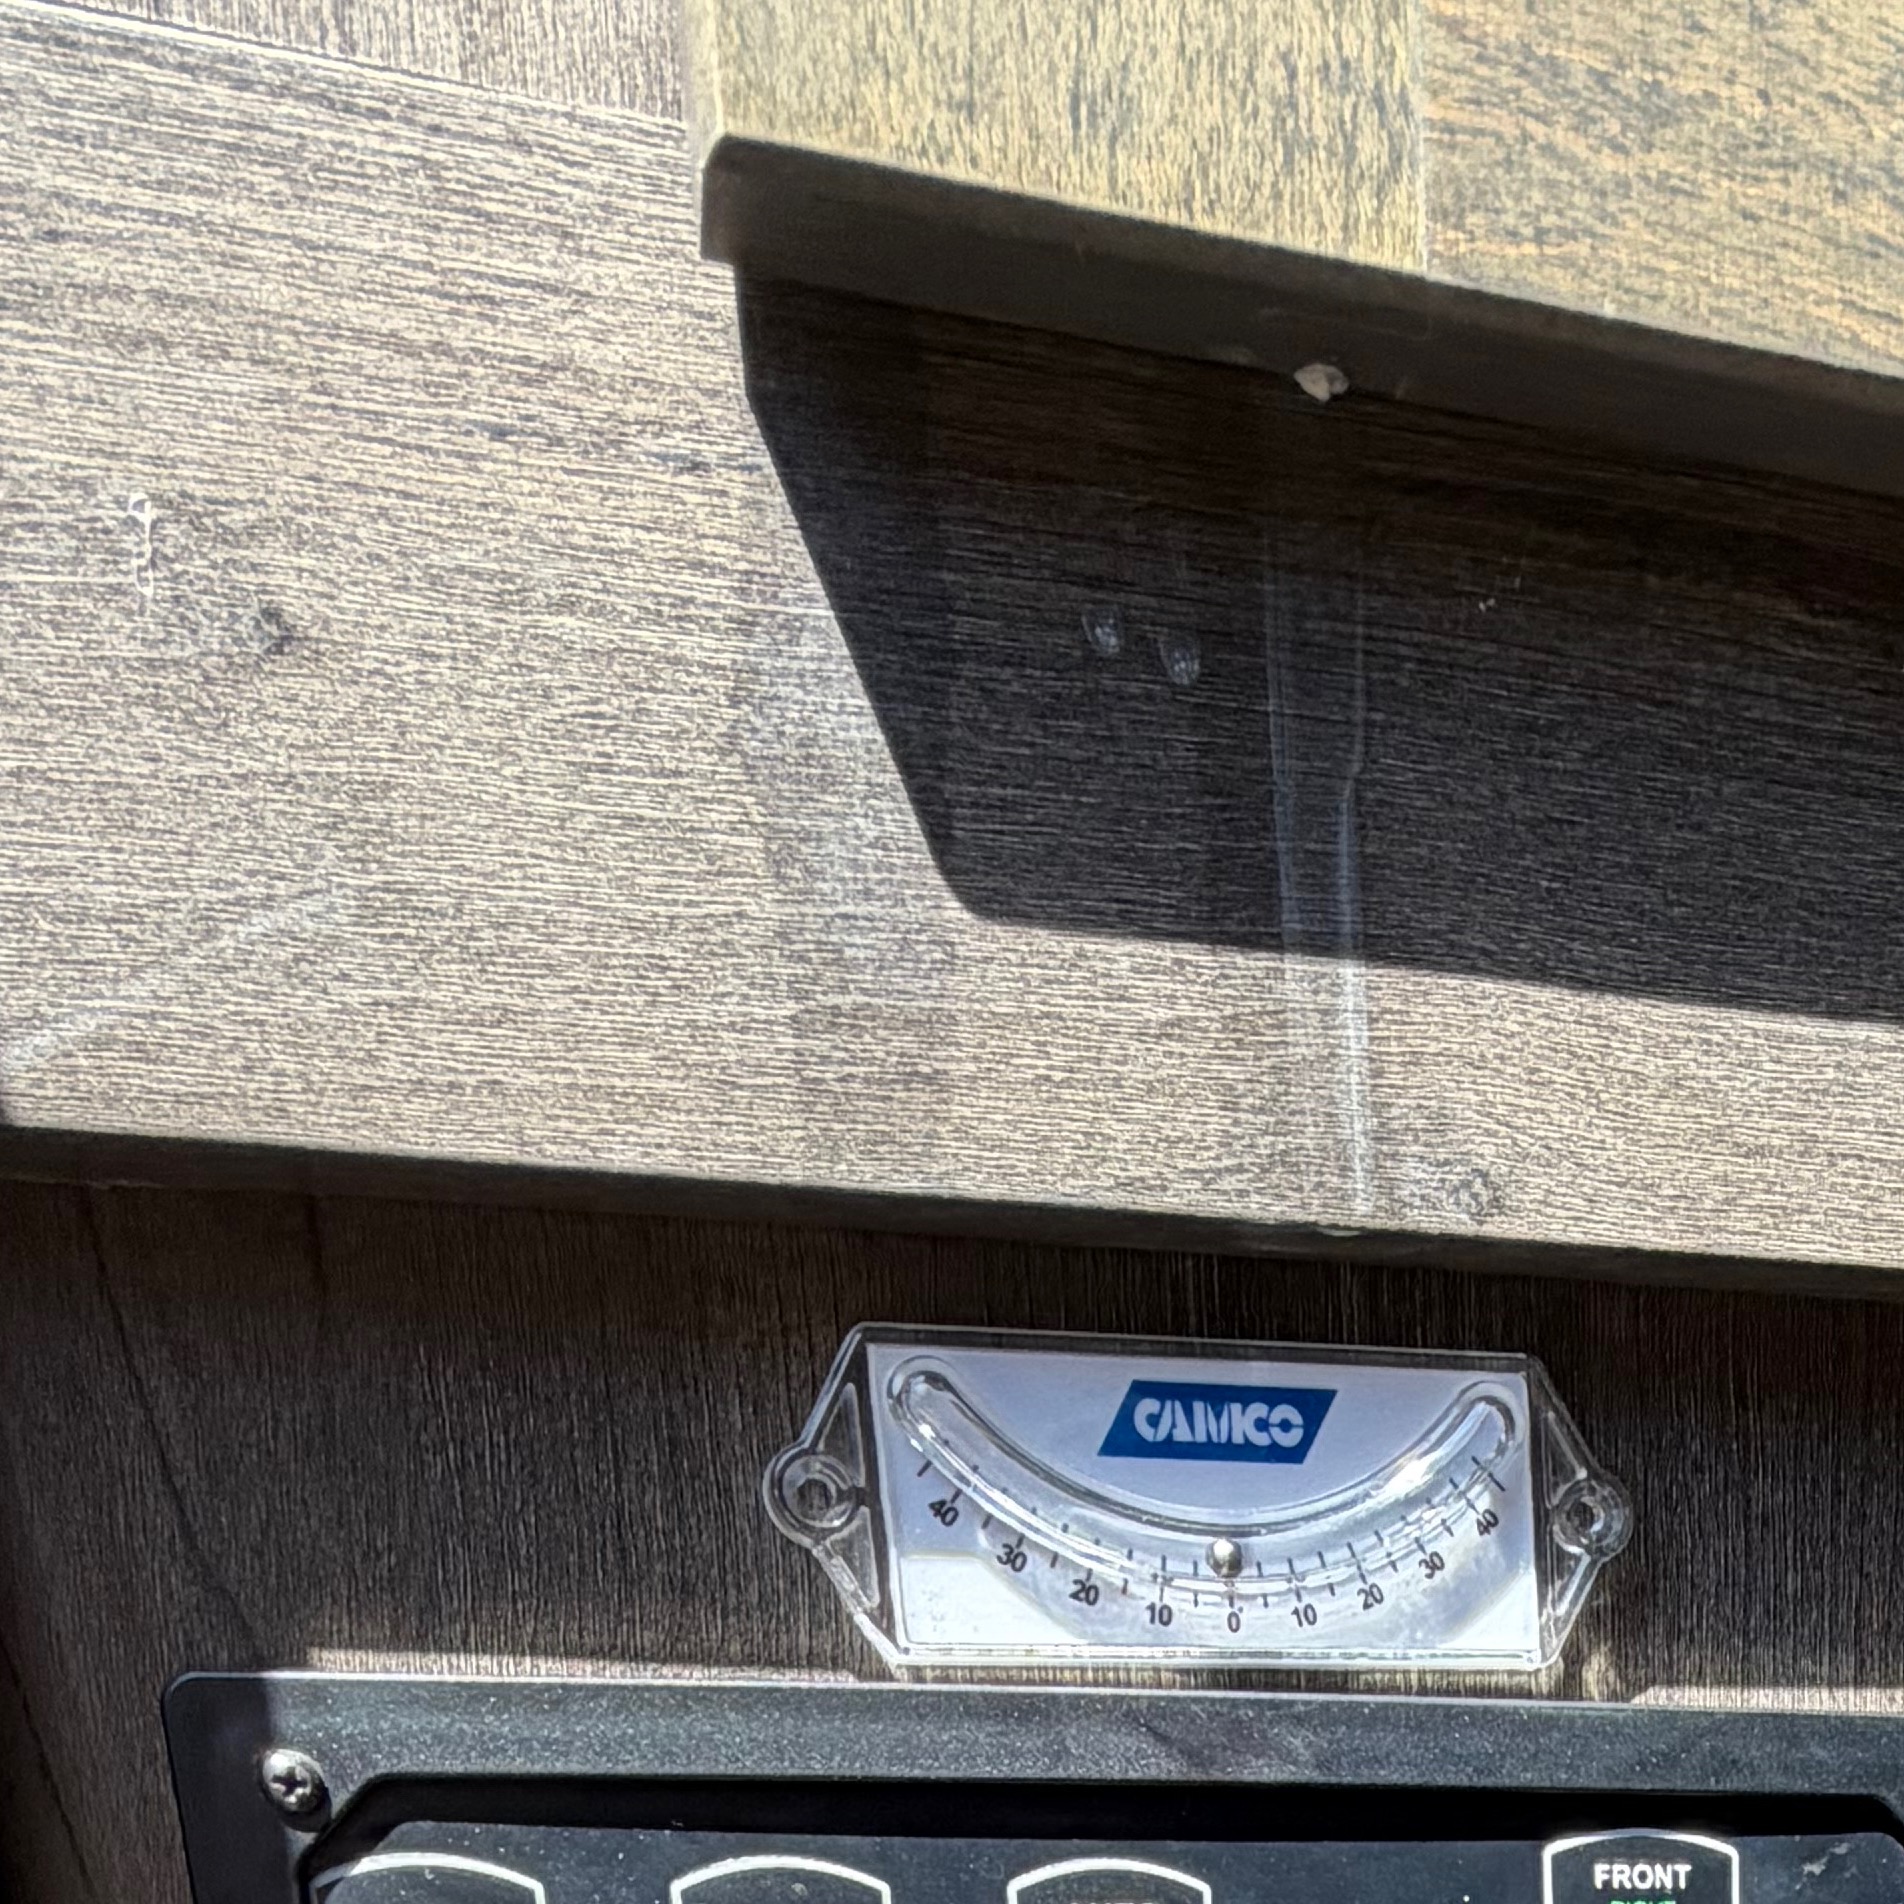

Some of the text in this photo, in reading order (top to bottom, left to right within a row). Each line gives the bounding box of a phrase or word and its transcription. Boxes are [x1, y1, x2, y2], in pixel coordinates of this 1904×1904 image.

[1134, 1398, 1304, 1448] CAMCO
[928, 1499, 960, 1527] 40
[996, 1543, 1028, 1573] 30
[1068, 1578, 1100, 1606] 20
[1145, 1601, 1174, 1627] 10
[1291, 1602, 1318, 1628] 10
[1357, 1582, 1385, 1611] 20
[1418, 1551, 1446, 1580] 30
[1476, 1508, 1500, 1537] 40
[1593, 1863, 1692, 1891] FRONT
